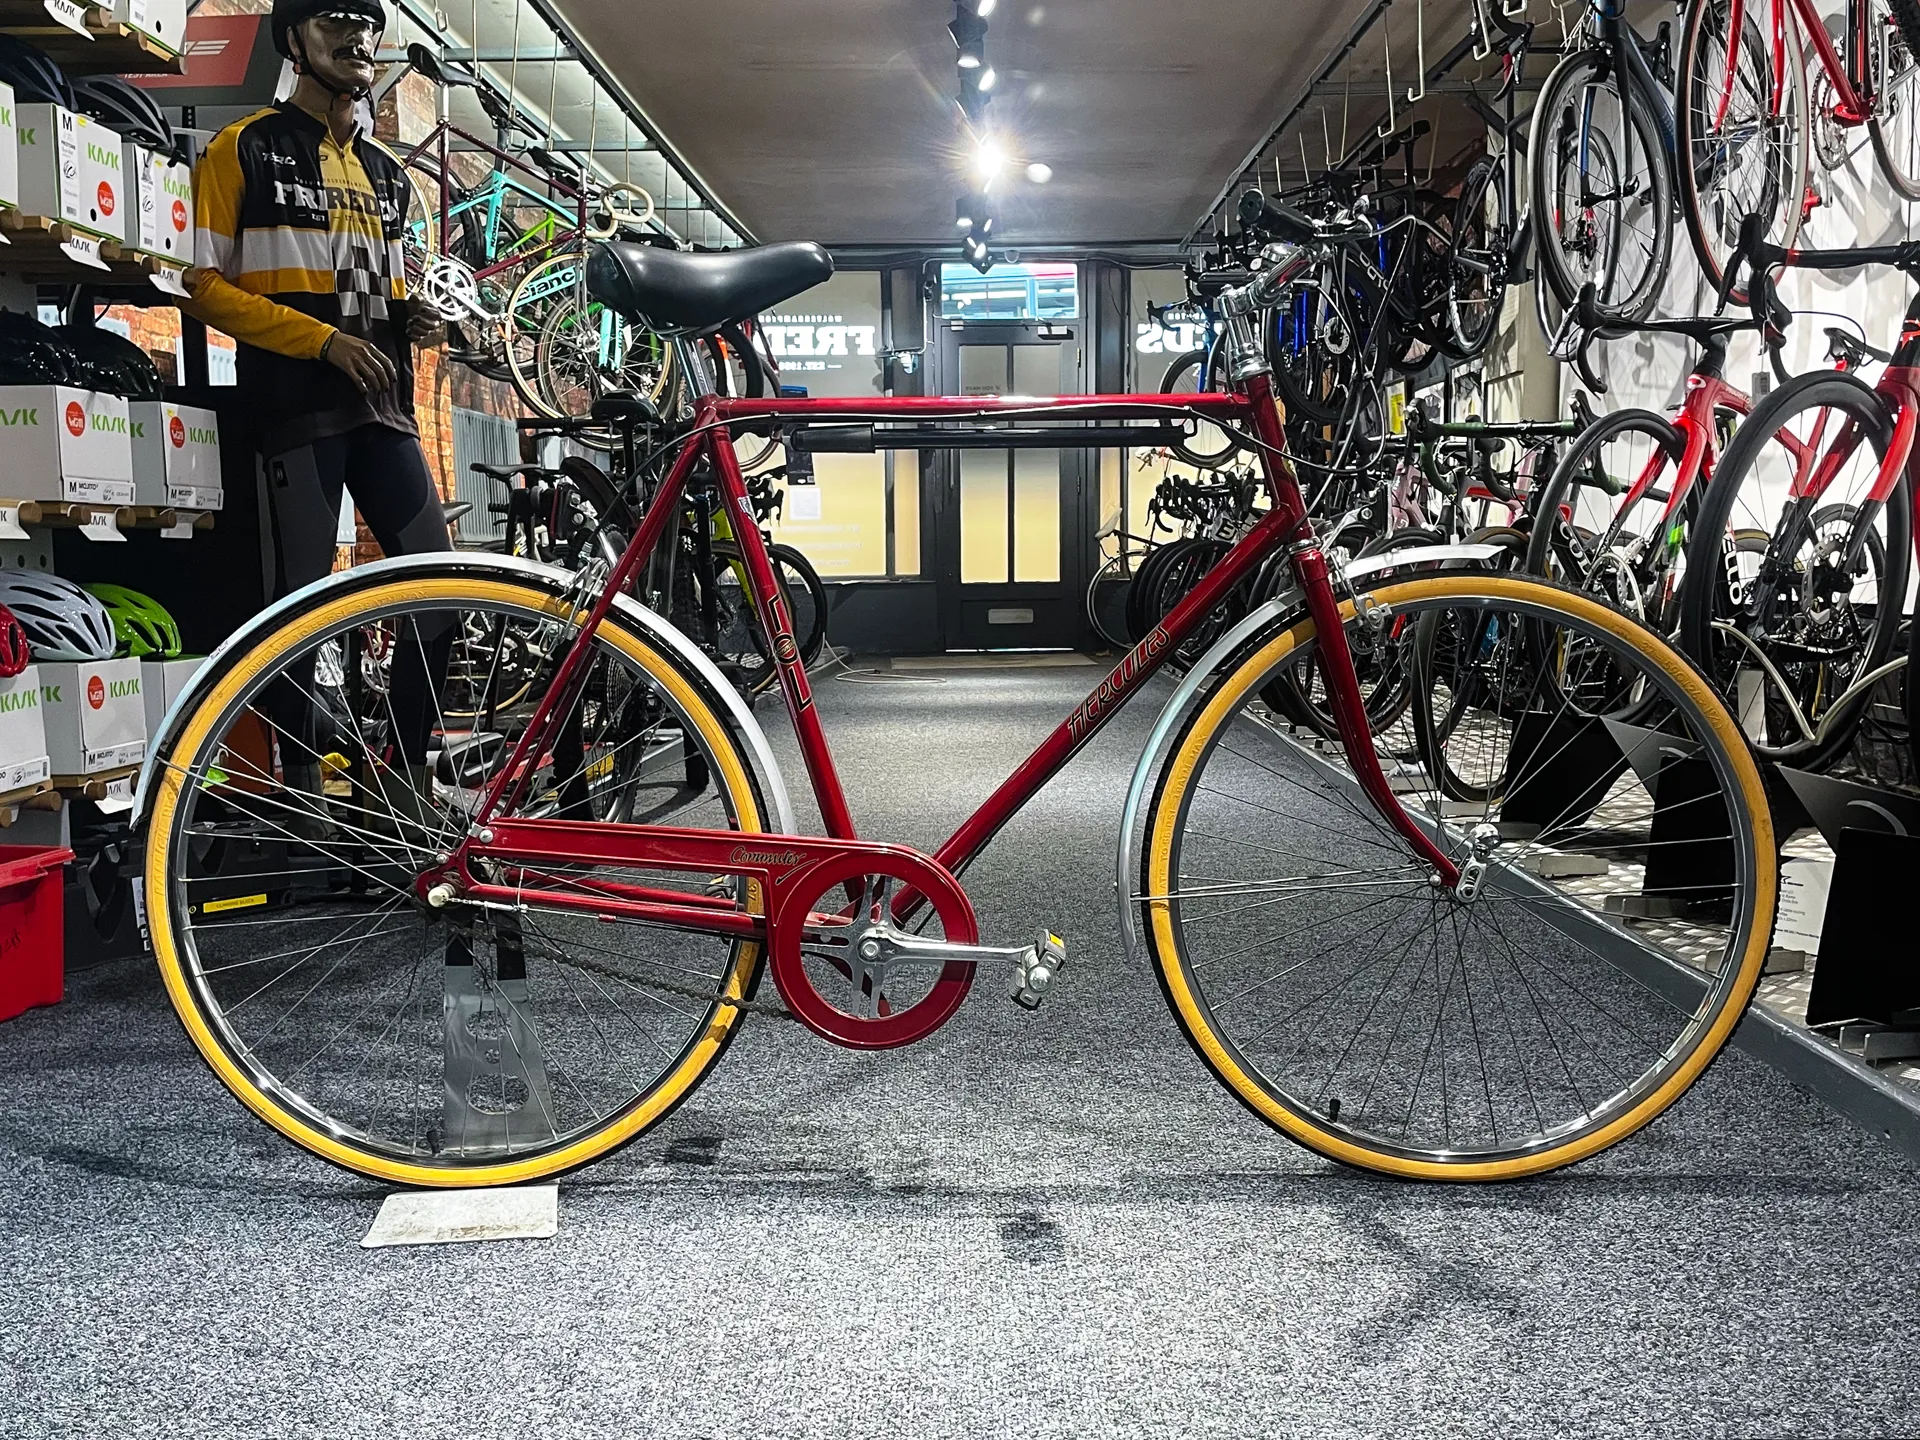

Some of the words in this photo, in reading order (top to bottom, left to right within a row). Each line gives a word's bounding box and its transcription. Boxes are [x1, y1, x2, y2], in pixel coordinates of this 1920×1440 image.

[62, 113, 73, 132] M
[87, 142, 119, 171] KASK
[163, 176, 192, 201] KASK
[518, 265, 578, 300] ianc
[0, 408, 39, 426] ASK
[92, 413, 127, 434] KASK
[189, 426, 217, 445] KASK
[69, 481, 77, 493] M
[171, 488, 177, 499] M
[110, 678, 140, 698] KASK
[1067, 625, 1170, 743] HERCULES
[0, 689, 37, 713] KASK
[88, 754, 96, 766] M
[730, 845, 807, 866] Commuter
[1195, 1021, 1236, 1071] RECORD
